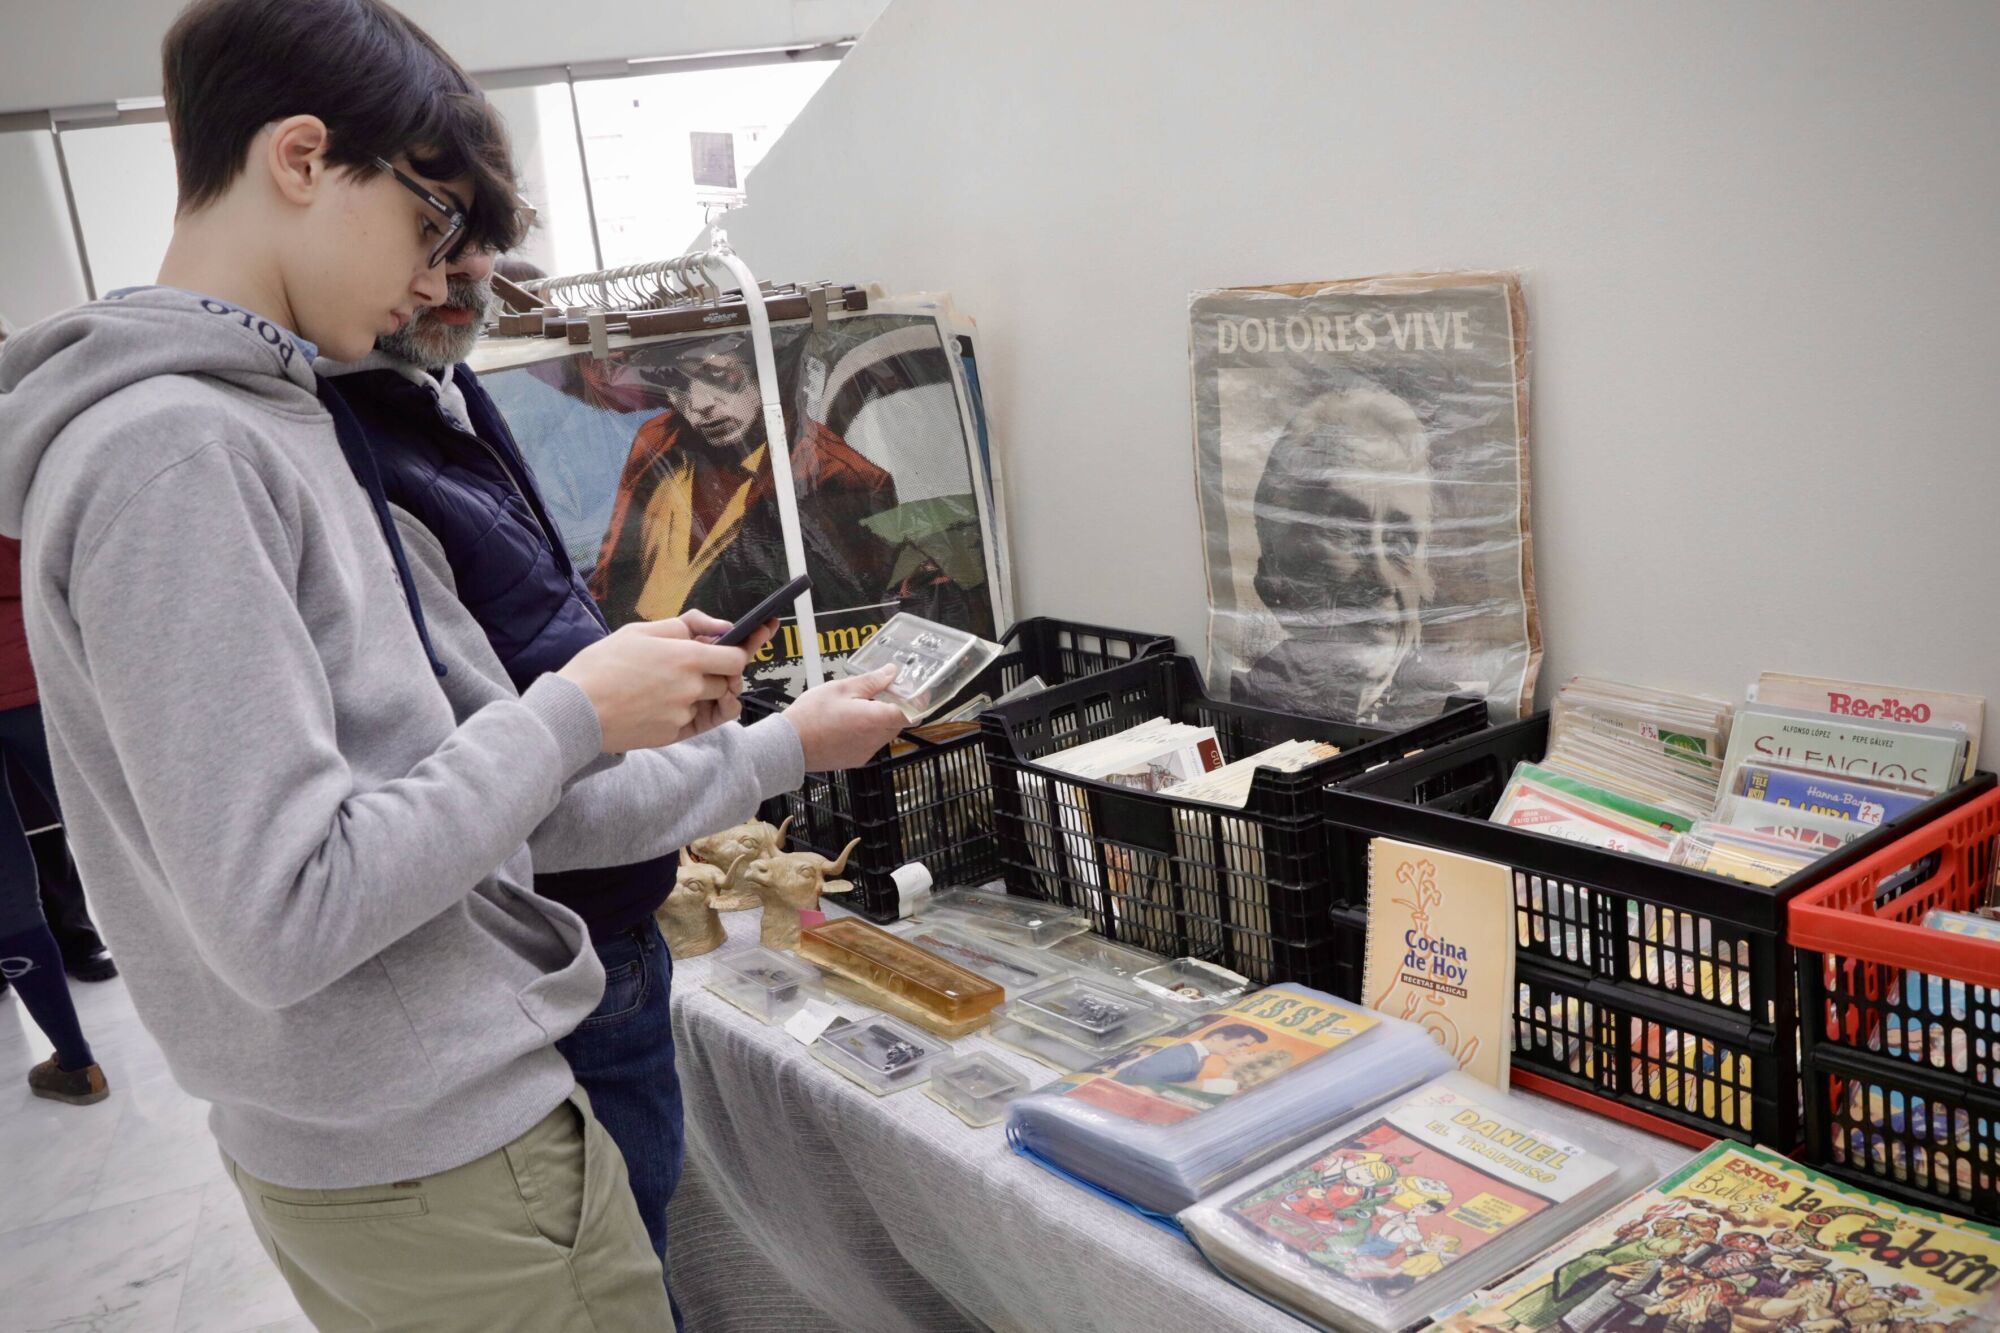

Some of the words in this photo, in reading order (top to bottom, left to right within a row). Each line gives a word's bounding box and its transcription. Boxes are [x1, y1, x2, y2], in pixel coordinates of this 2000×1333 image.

[201, 300, 294, 369] POLO
[1217, 313, 1376, 354] DOLORES
[1386, 311, 1474, 350] VIVE
[1827, 692, 1932, 724] Recreo
[1782, 725, 1810, 736] ALFONSO
[1811, 726, 1832, 739] LÓPEZ
[1852, 735, 1869, 745] PEPE
[1870, 737, 1895, 749] GÁLVEZ
[1404, 929, 1467, 961] Cocina
[1403, 974, 1434, 989] RECETAS
[1404, 949, 1426, 971] de
[1433, 955, 1467, 986] Hoy
[1425, 1119, 1449, 1138] EL
[1456, 1134, 1558, 1184] TRAVIESO
[1451, 1108, 1570, 1171] DANIEL
[1724, 1158, 1791, 1193] EXTRA
[1780, 1186, 1822, 1212] la
